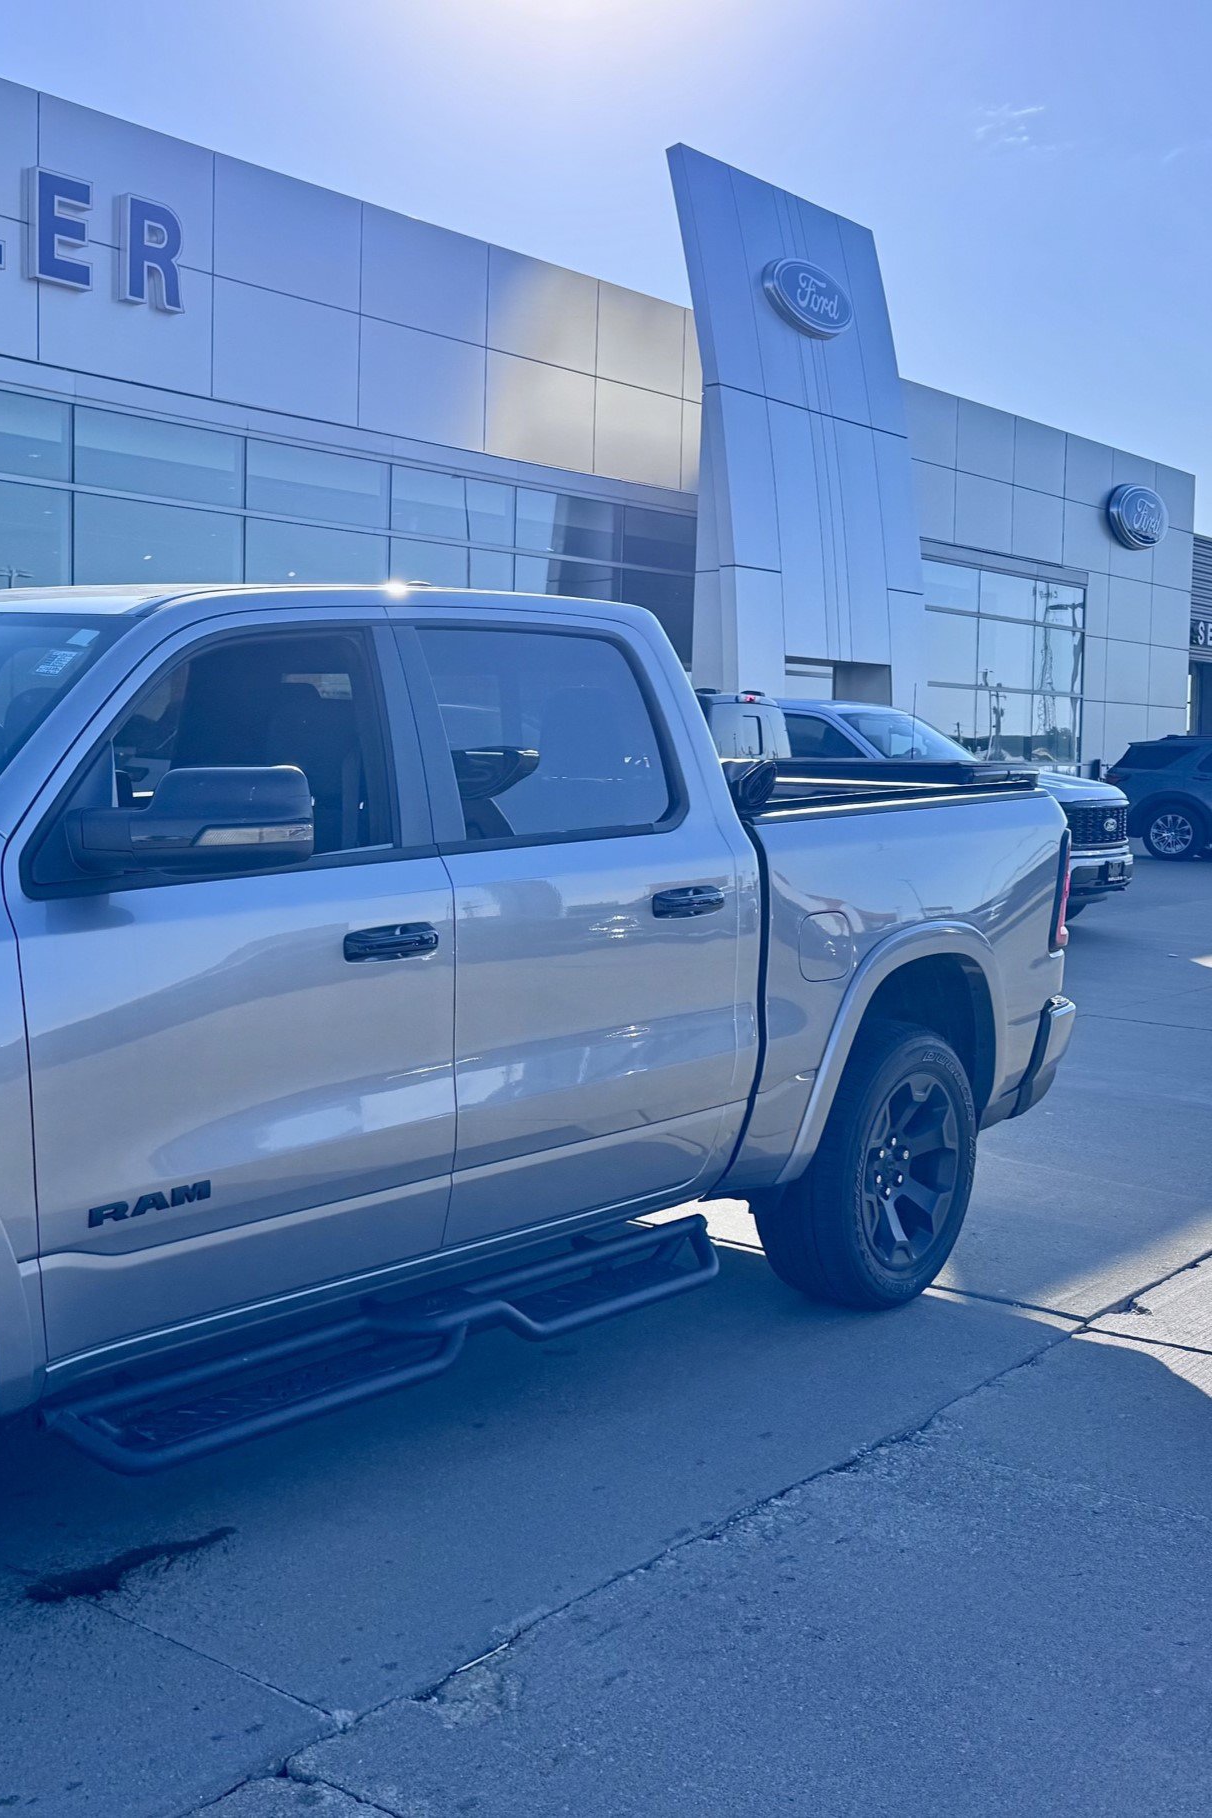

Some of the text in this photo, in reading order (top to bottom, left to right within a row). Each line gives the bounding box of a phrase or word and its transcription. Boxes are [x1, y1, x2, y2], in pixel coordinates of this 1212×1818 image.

[797, 272, 840, 320] Ford
[1133, 498, 1161, 535] Ford
[88, 1179, 211, 1228] RAM
